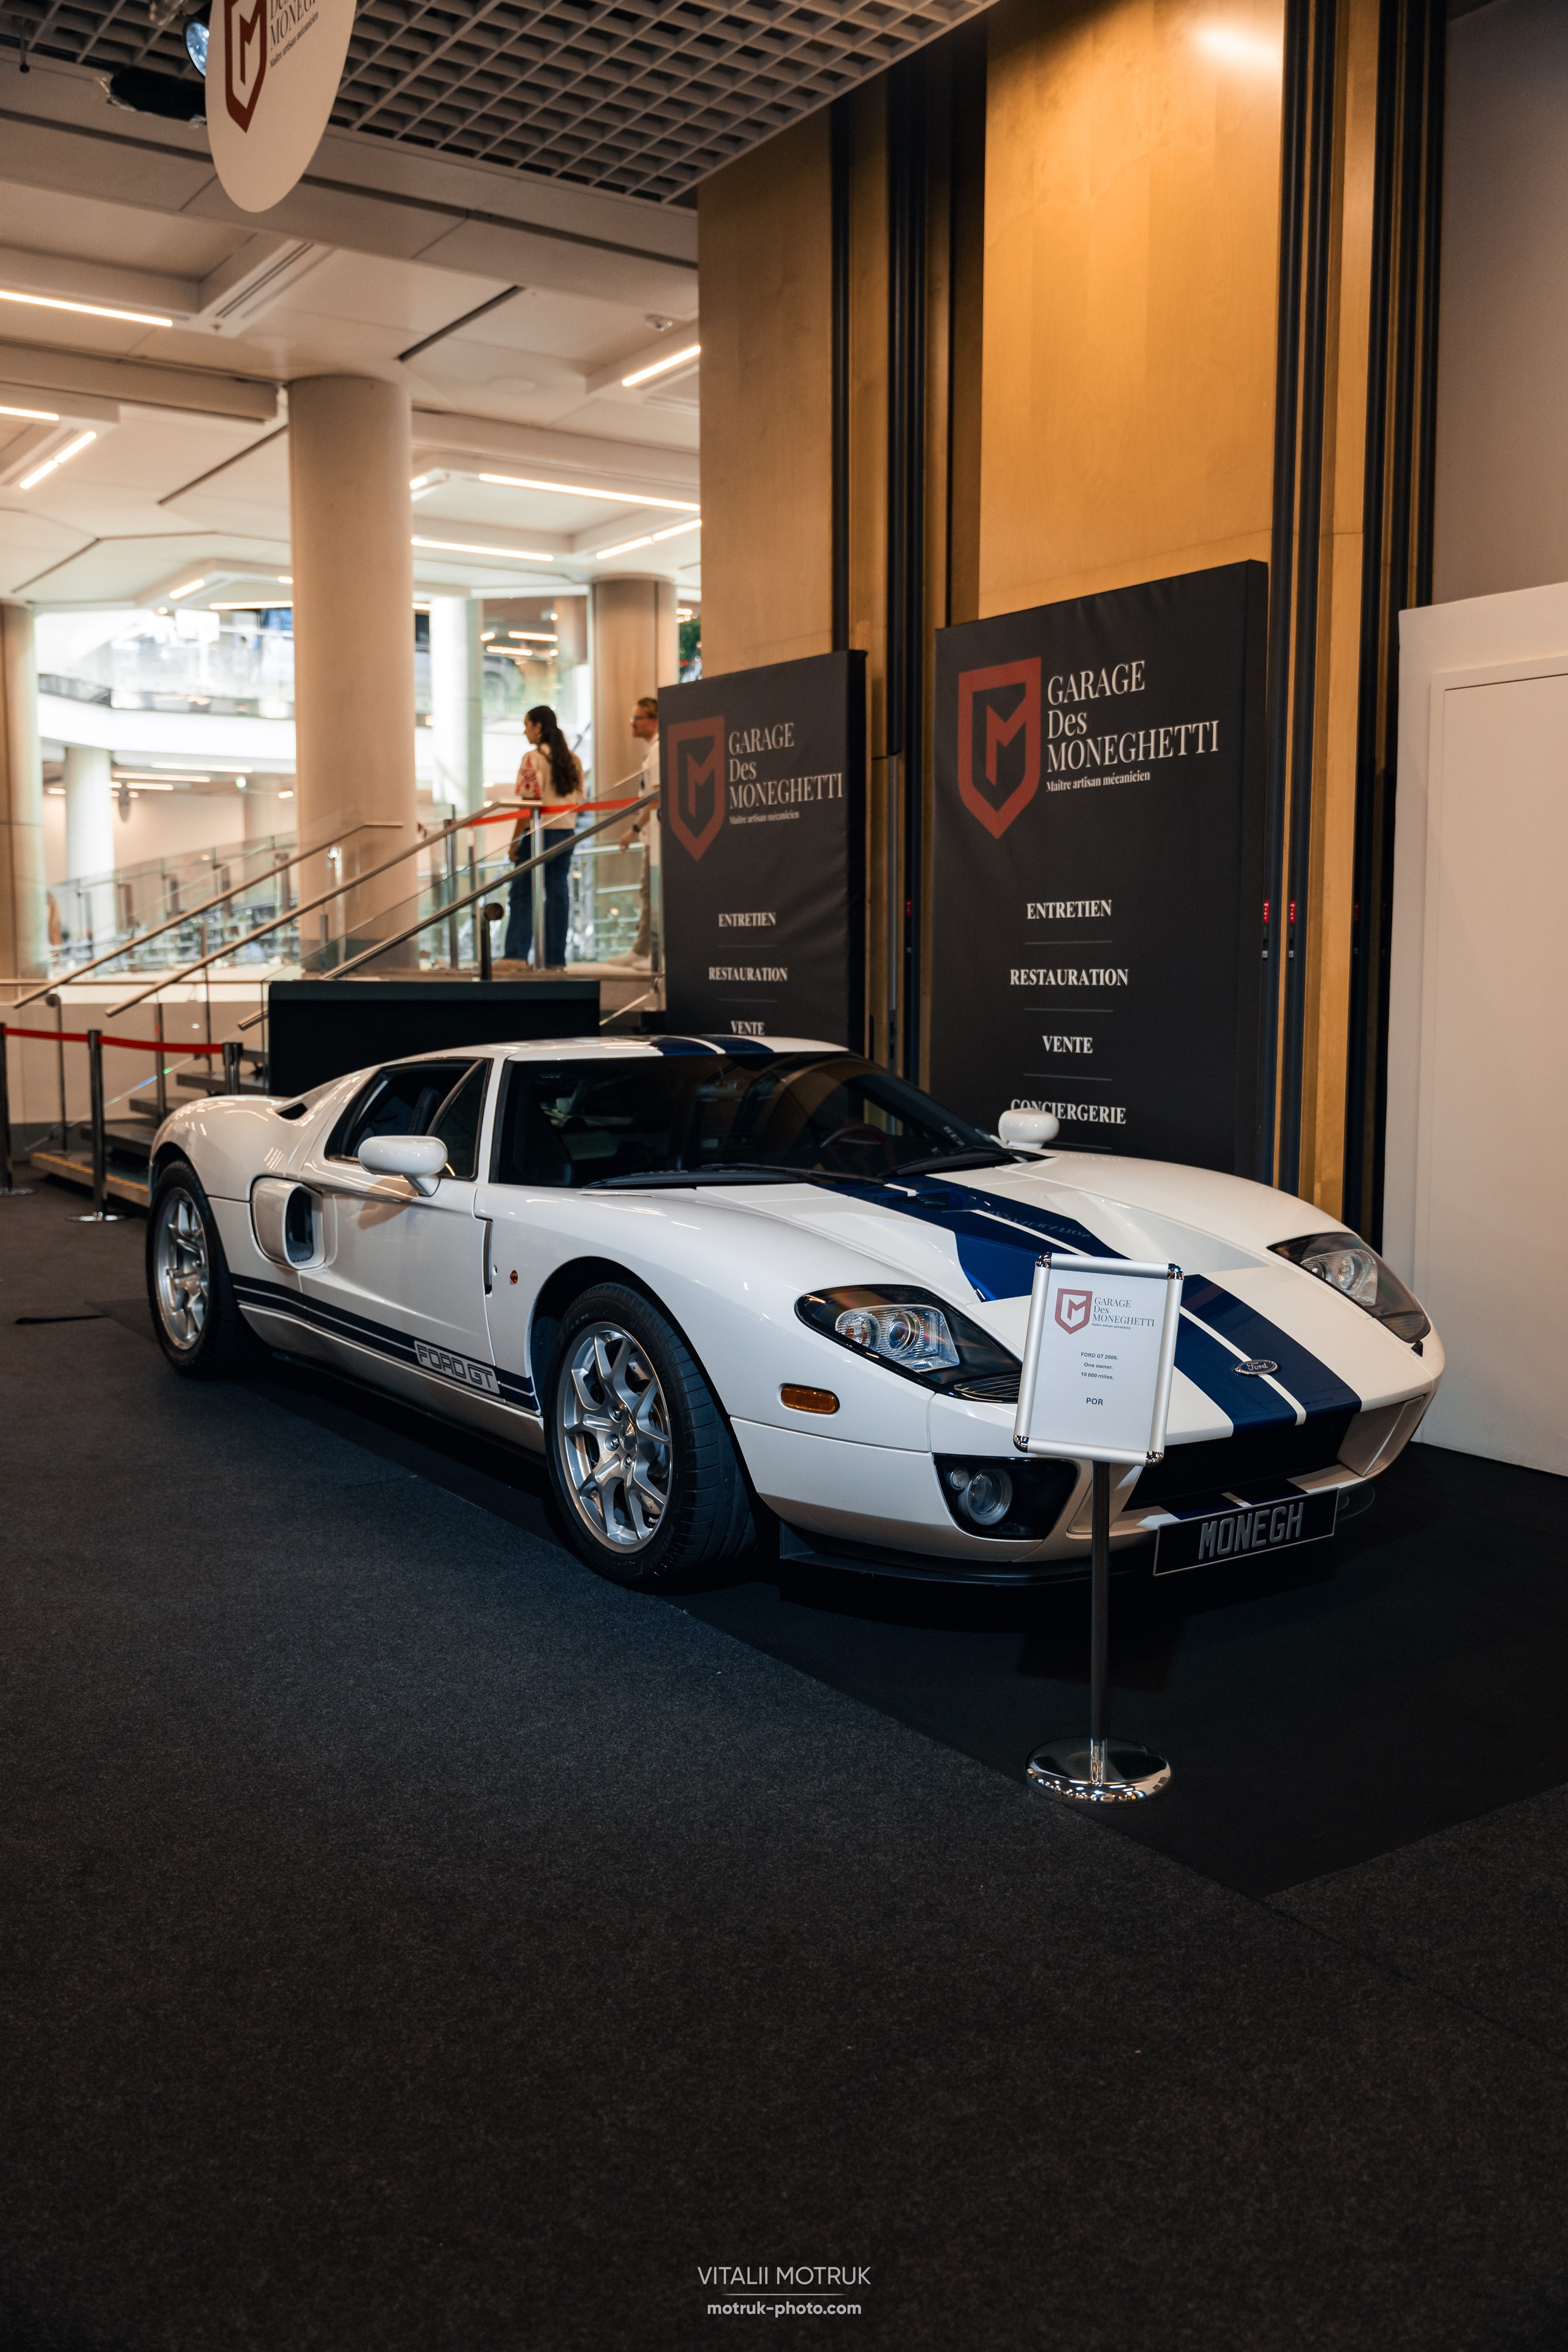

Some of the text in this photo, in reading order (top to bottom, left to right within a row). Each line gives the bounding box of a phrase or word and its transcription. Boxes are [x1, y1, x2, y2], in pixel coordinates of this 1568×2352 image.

[1047, 659, 1146, 706] GARAGE
[1047, 709, 1088, 739] Des
[729, 722, 795, 755] GARAGE
[1047, 720, 1219, 773] MONEGHETTI
[729, 758, 757, 782] Des
[1072, 776, 1101, 790] artisan
[1102, 769, 1151, 785] mécanicien
[729, 772, 843, 810] MONEGHETTI
[1027, 899, 1112, 919] ENTRETIEN
[718, 912, 776, 927] ENTRETIEN
[708, 967, 788, 982] RESTAURATION
[1010, 968, 1128, 986] RESTAURATION
[731, 1020, 765, 1036] VENTE
[1042, 1035, 1093, 1054] VENTE
[1093, 1305, 1109, 1314] Des
[1095, 1297, 1131, 1308] GARAGE
[1092, 1313, 1155, 1327] MONEGHETTI
[417, 1344, 492, 1389] FORD GT
[1246, 1362, 1268, 1371] Ford
[1086, 1397, 1103, 1406] POR
[1199, 1502, 1304, 1560] MONEGH
